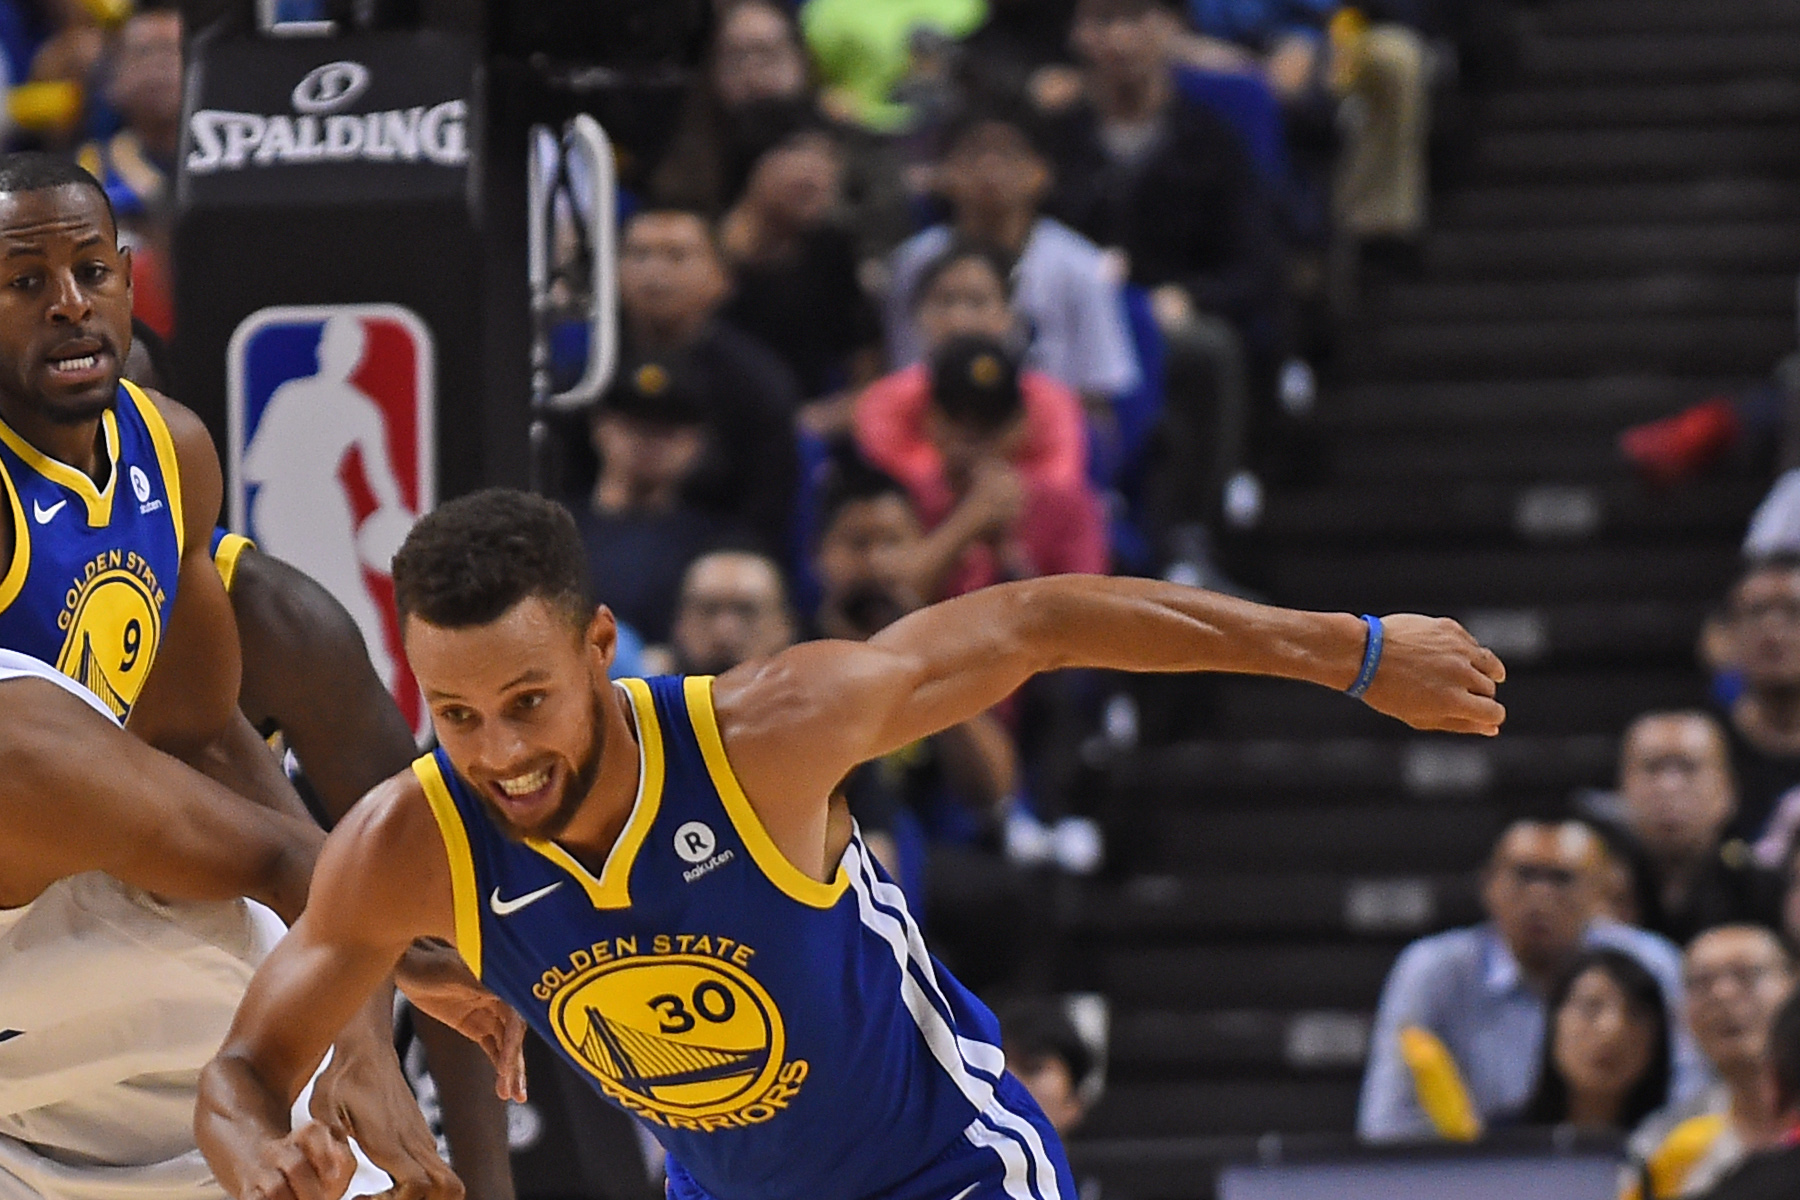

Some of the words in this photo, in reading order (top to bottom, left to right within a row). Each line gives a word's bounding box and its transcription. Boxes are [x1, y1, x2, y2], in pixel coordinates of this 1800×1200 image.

[187, 99, 469, 174] SPALDING
[57, 548, 122, 631] GOLDEN
[126, 551, 166, 609] STATE
[119, 618, 142, 673] 9
[682, 849, 735, 883] Rakuten
[684, 831, 709, 855] R
[532, 935, 638, 1002] GOLDEN
[653, 933, 756, 967] STATE
[647, 979, 736, 1034] 30
